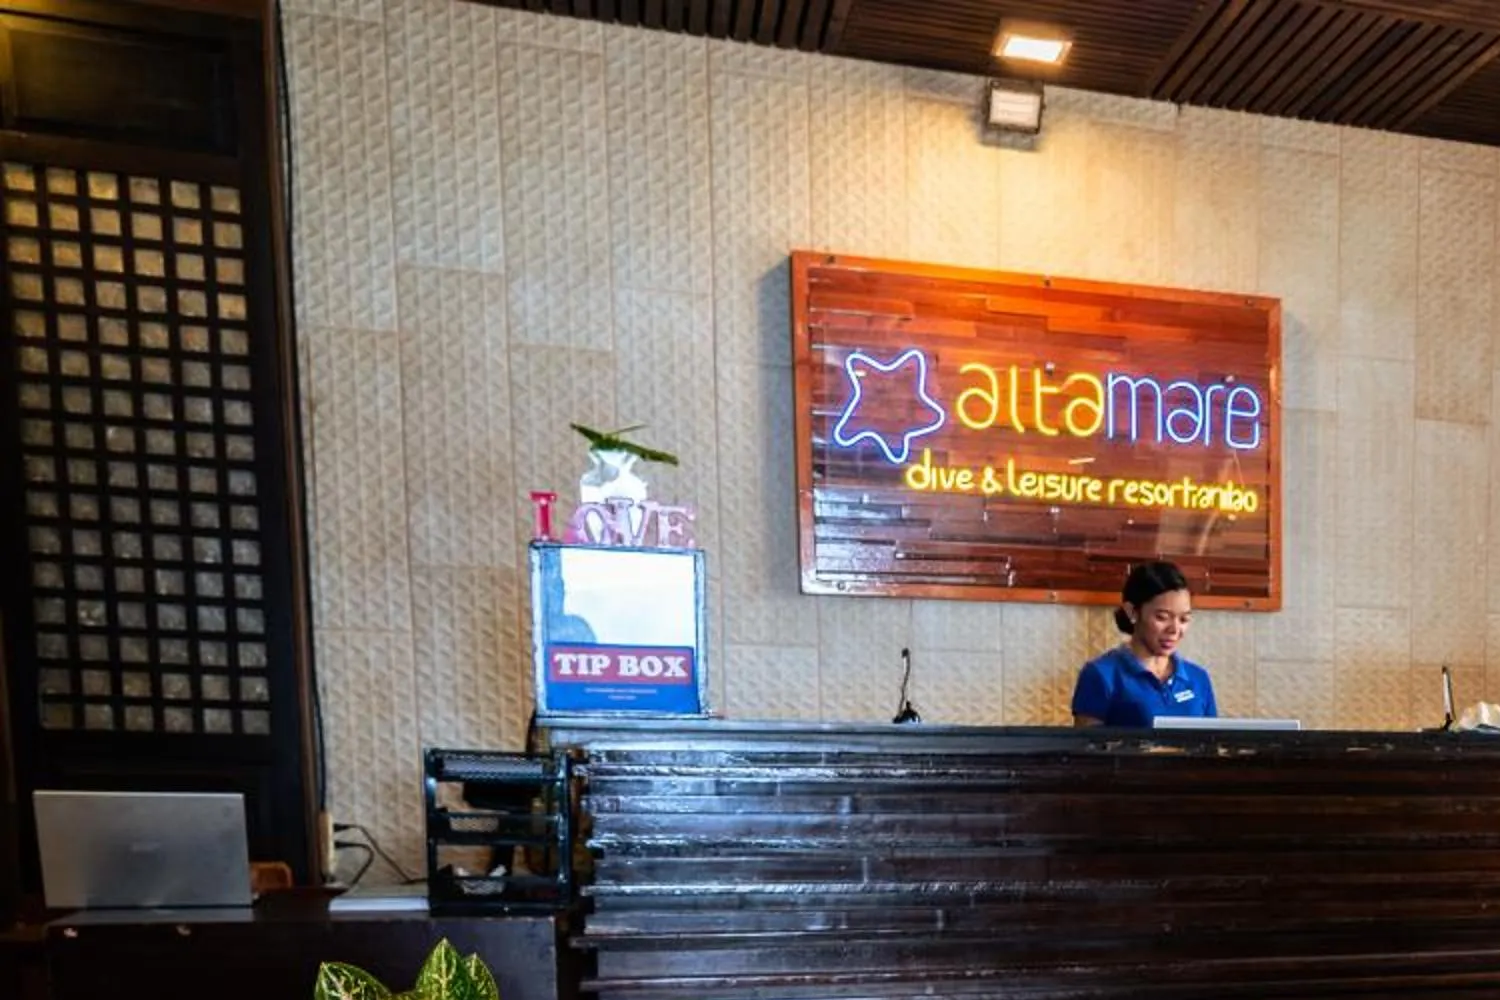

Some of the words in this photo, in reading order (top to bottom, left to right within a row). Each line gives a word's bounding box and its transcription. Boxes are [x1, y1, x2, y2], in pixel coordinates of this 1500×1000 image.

[956, 361, 1262, 449] altamare
[906, 447, 975, 491] dive
[979, 464, 1003, 495] &
[1007, 458, 1101, 501] leisure
[553, 652, 611, 676] TIP
[616, 654, 689, 678] BOX
